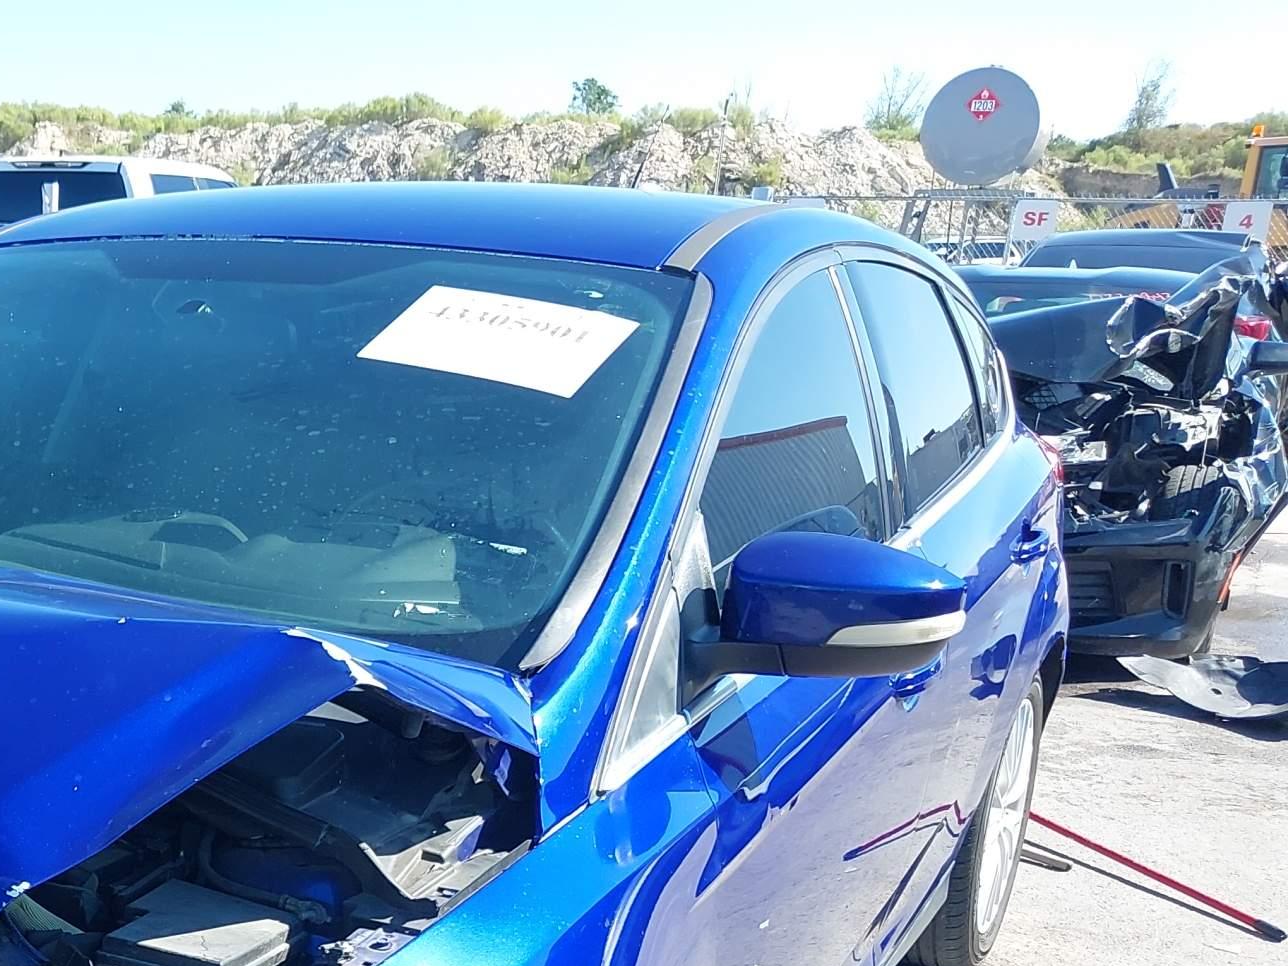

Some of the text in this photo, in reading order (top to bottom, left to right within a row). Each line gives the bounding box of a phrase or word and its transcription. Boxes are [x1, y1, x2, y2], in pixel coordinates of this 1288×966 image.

[973, 101, 994, 111] 1203
[1023, 211, 1049, 226] SF
[1239, 214, 1253, 229] 4
